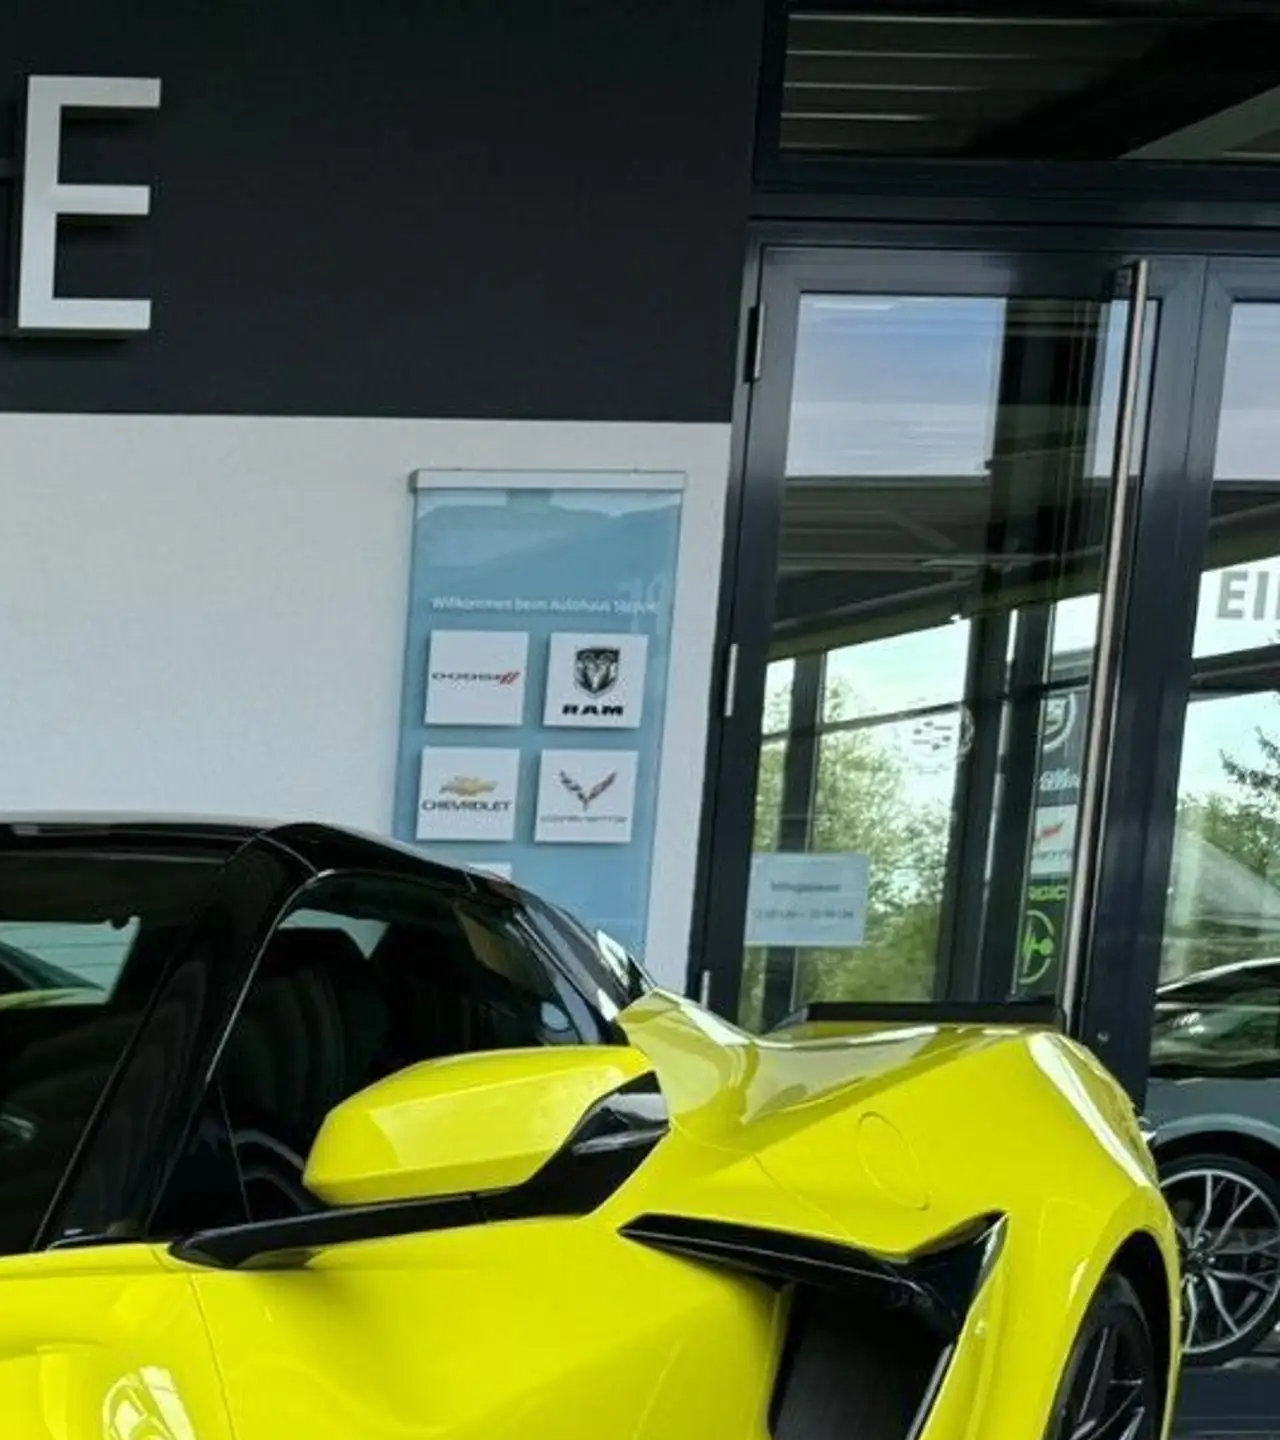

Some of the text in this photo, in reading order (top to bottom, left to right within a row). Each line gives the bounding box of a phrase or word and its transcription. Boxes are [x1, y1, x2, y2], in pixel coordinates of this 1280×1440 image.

[1216, 570, 1279, 620] EI
[562, 704, 624, 716] RAM
[421, 800, 511, 812] CHEVROLET
